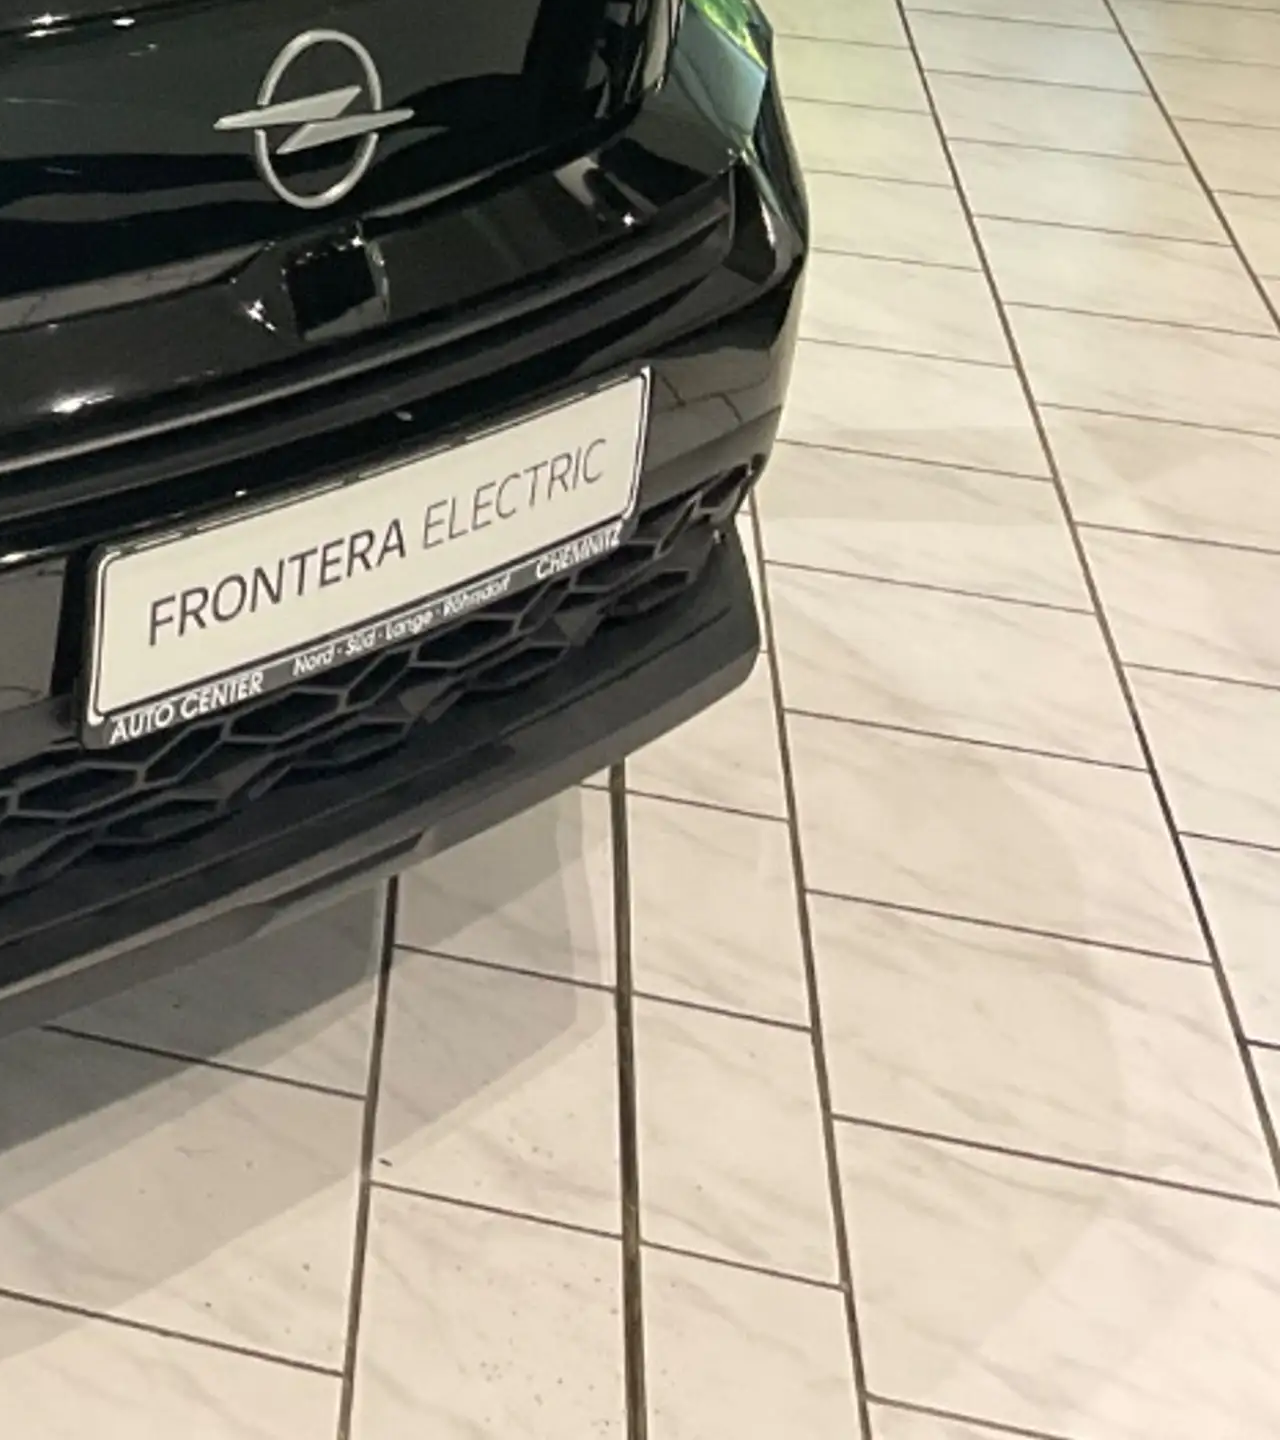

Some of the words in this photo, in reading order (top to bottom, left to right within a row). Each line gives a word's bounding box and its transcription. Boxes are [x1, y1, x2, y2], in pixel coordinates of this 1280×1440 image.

[109, 704, 174, 746] AUTO
[179, 671, 264, 720] CENTER
[292, 643, 335, 677] Nord
[535, 523, 623, 579] CHEMNITZ
[148, 517, 407, 647] FRONTERA
[422, 437, 607, 550] ELECTRIC
